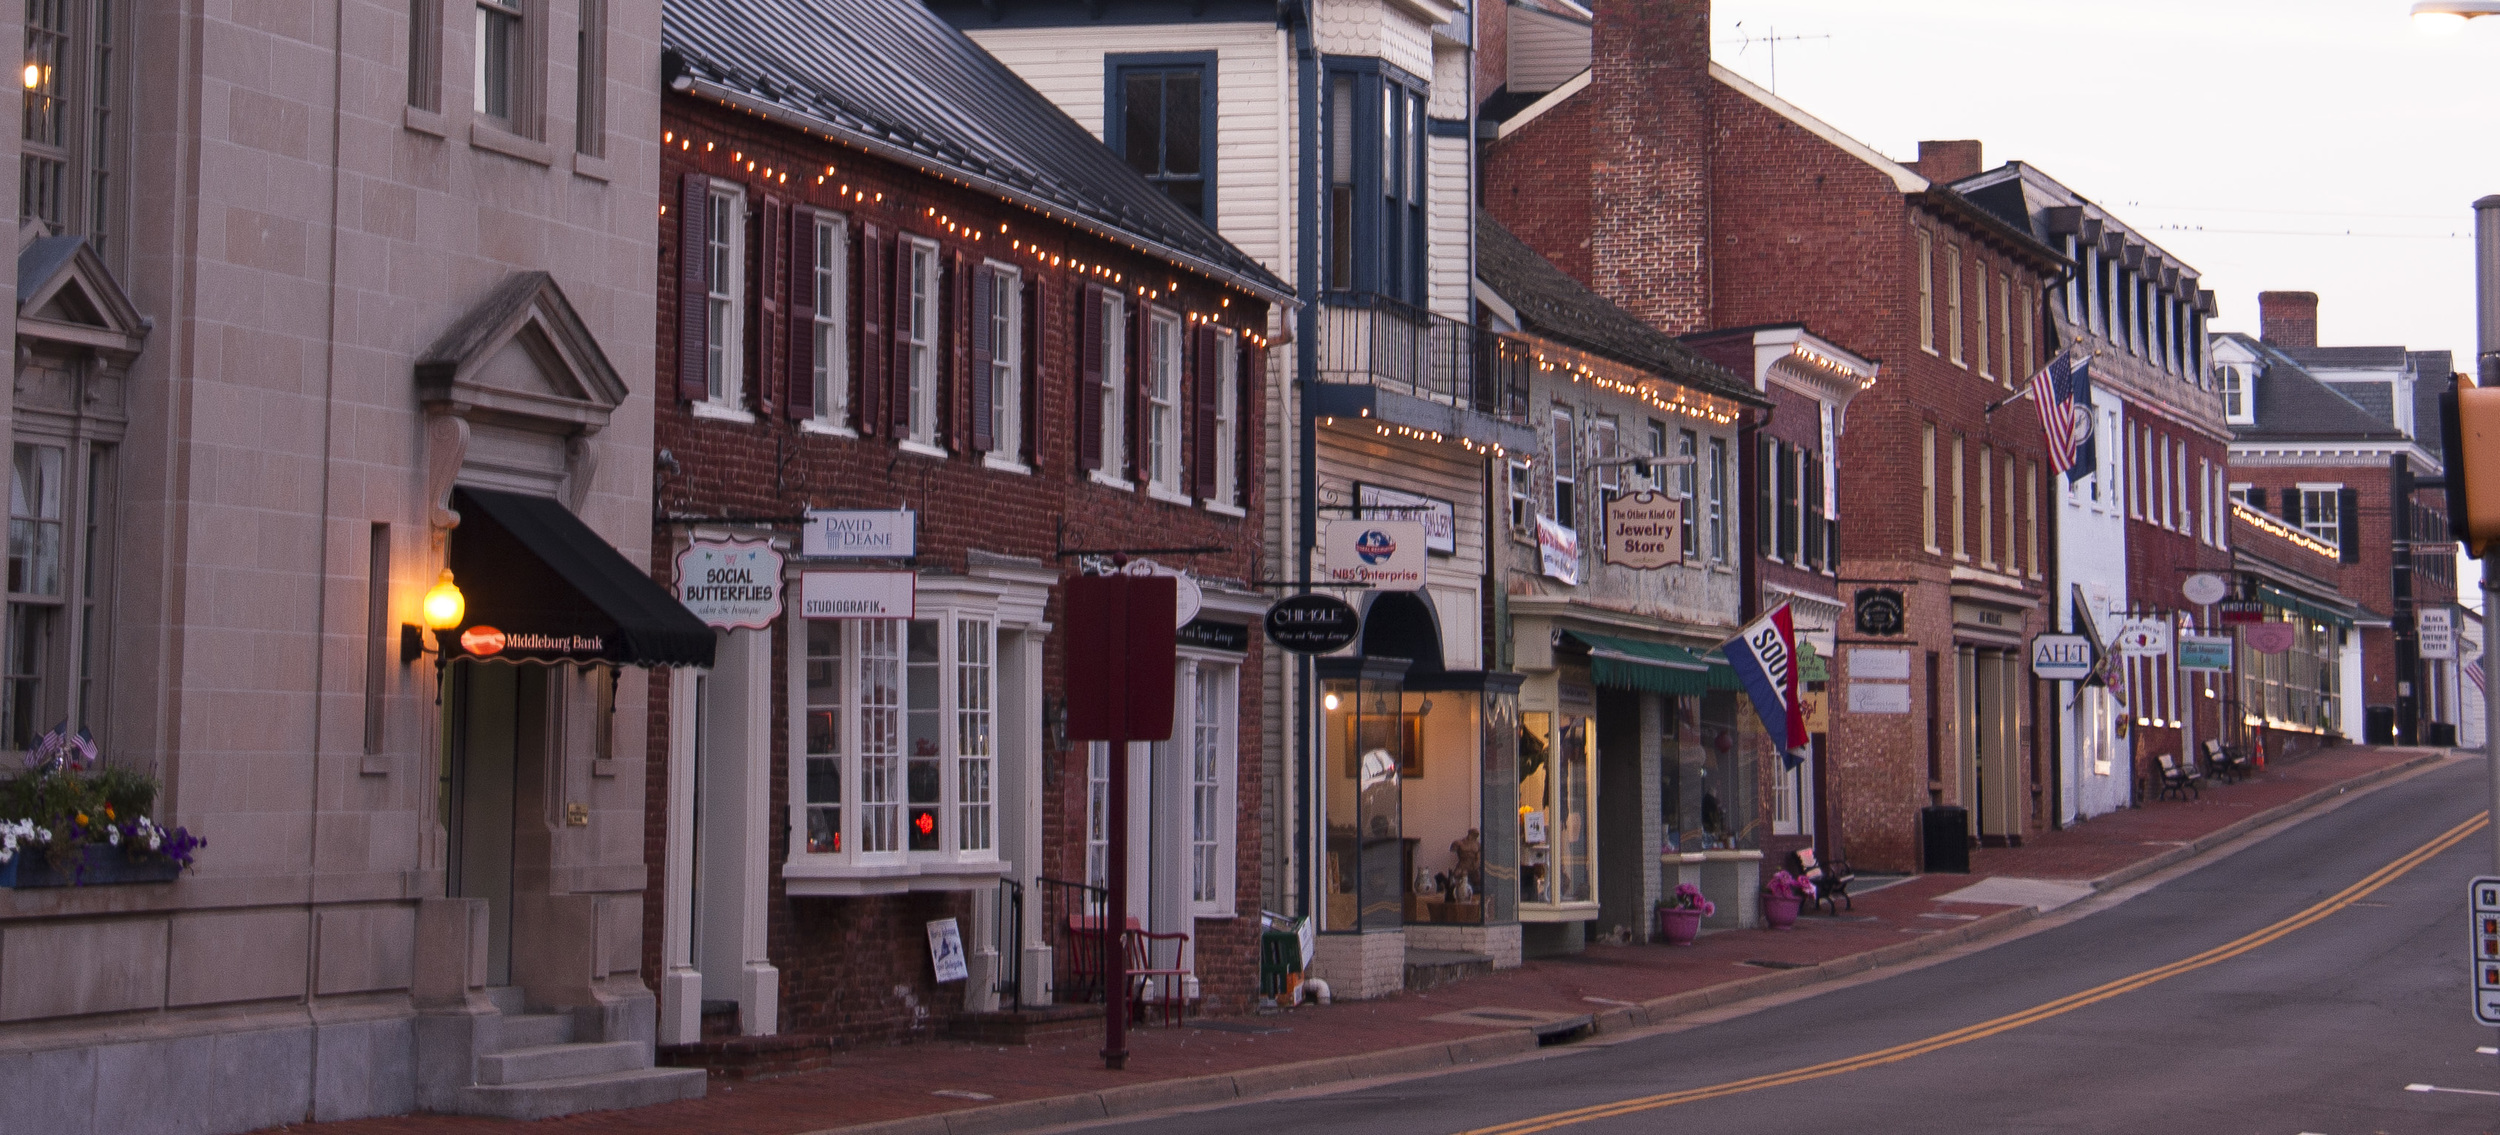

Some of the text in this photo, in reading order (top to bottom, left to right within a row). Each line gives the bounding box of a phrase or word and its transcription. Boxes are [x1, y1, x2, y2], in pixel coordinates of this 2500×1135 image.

[1613, 509, 1675, 519] The Other Kind Of
[826, 517, 872, 531] DAVID
[1616, 522, 1673, 540] Jewelry
[844, 532, 892, 546] DEANE
[1625, 539, 1665, 553] Store
[706, 568, 753, 584] SOCIAL
[1332, 568, 1418, 583] NBS Enterprise
[686, 585, 773, 601] BUTTERFLIES
[2221, 601, 2263, 612] WINDY CITY
[2424, 615, 2443, 623] BLACK
[2421, 624, 2448, 632] SHUTTER
[506, 632, 603, 652] Middleburg Bank
[2421, 633, 2448, 641] ANTIQUE
[2036, 643, 2088, 662] AH&T
[2423, 642, 2447, 651] CENTER
